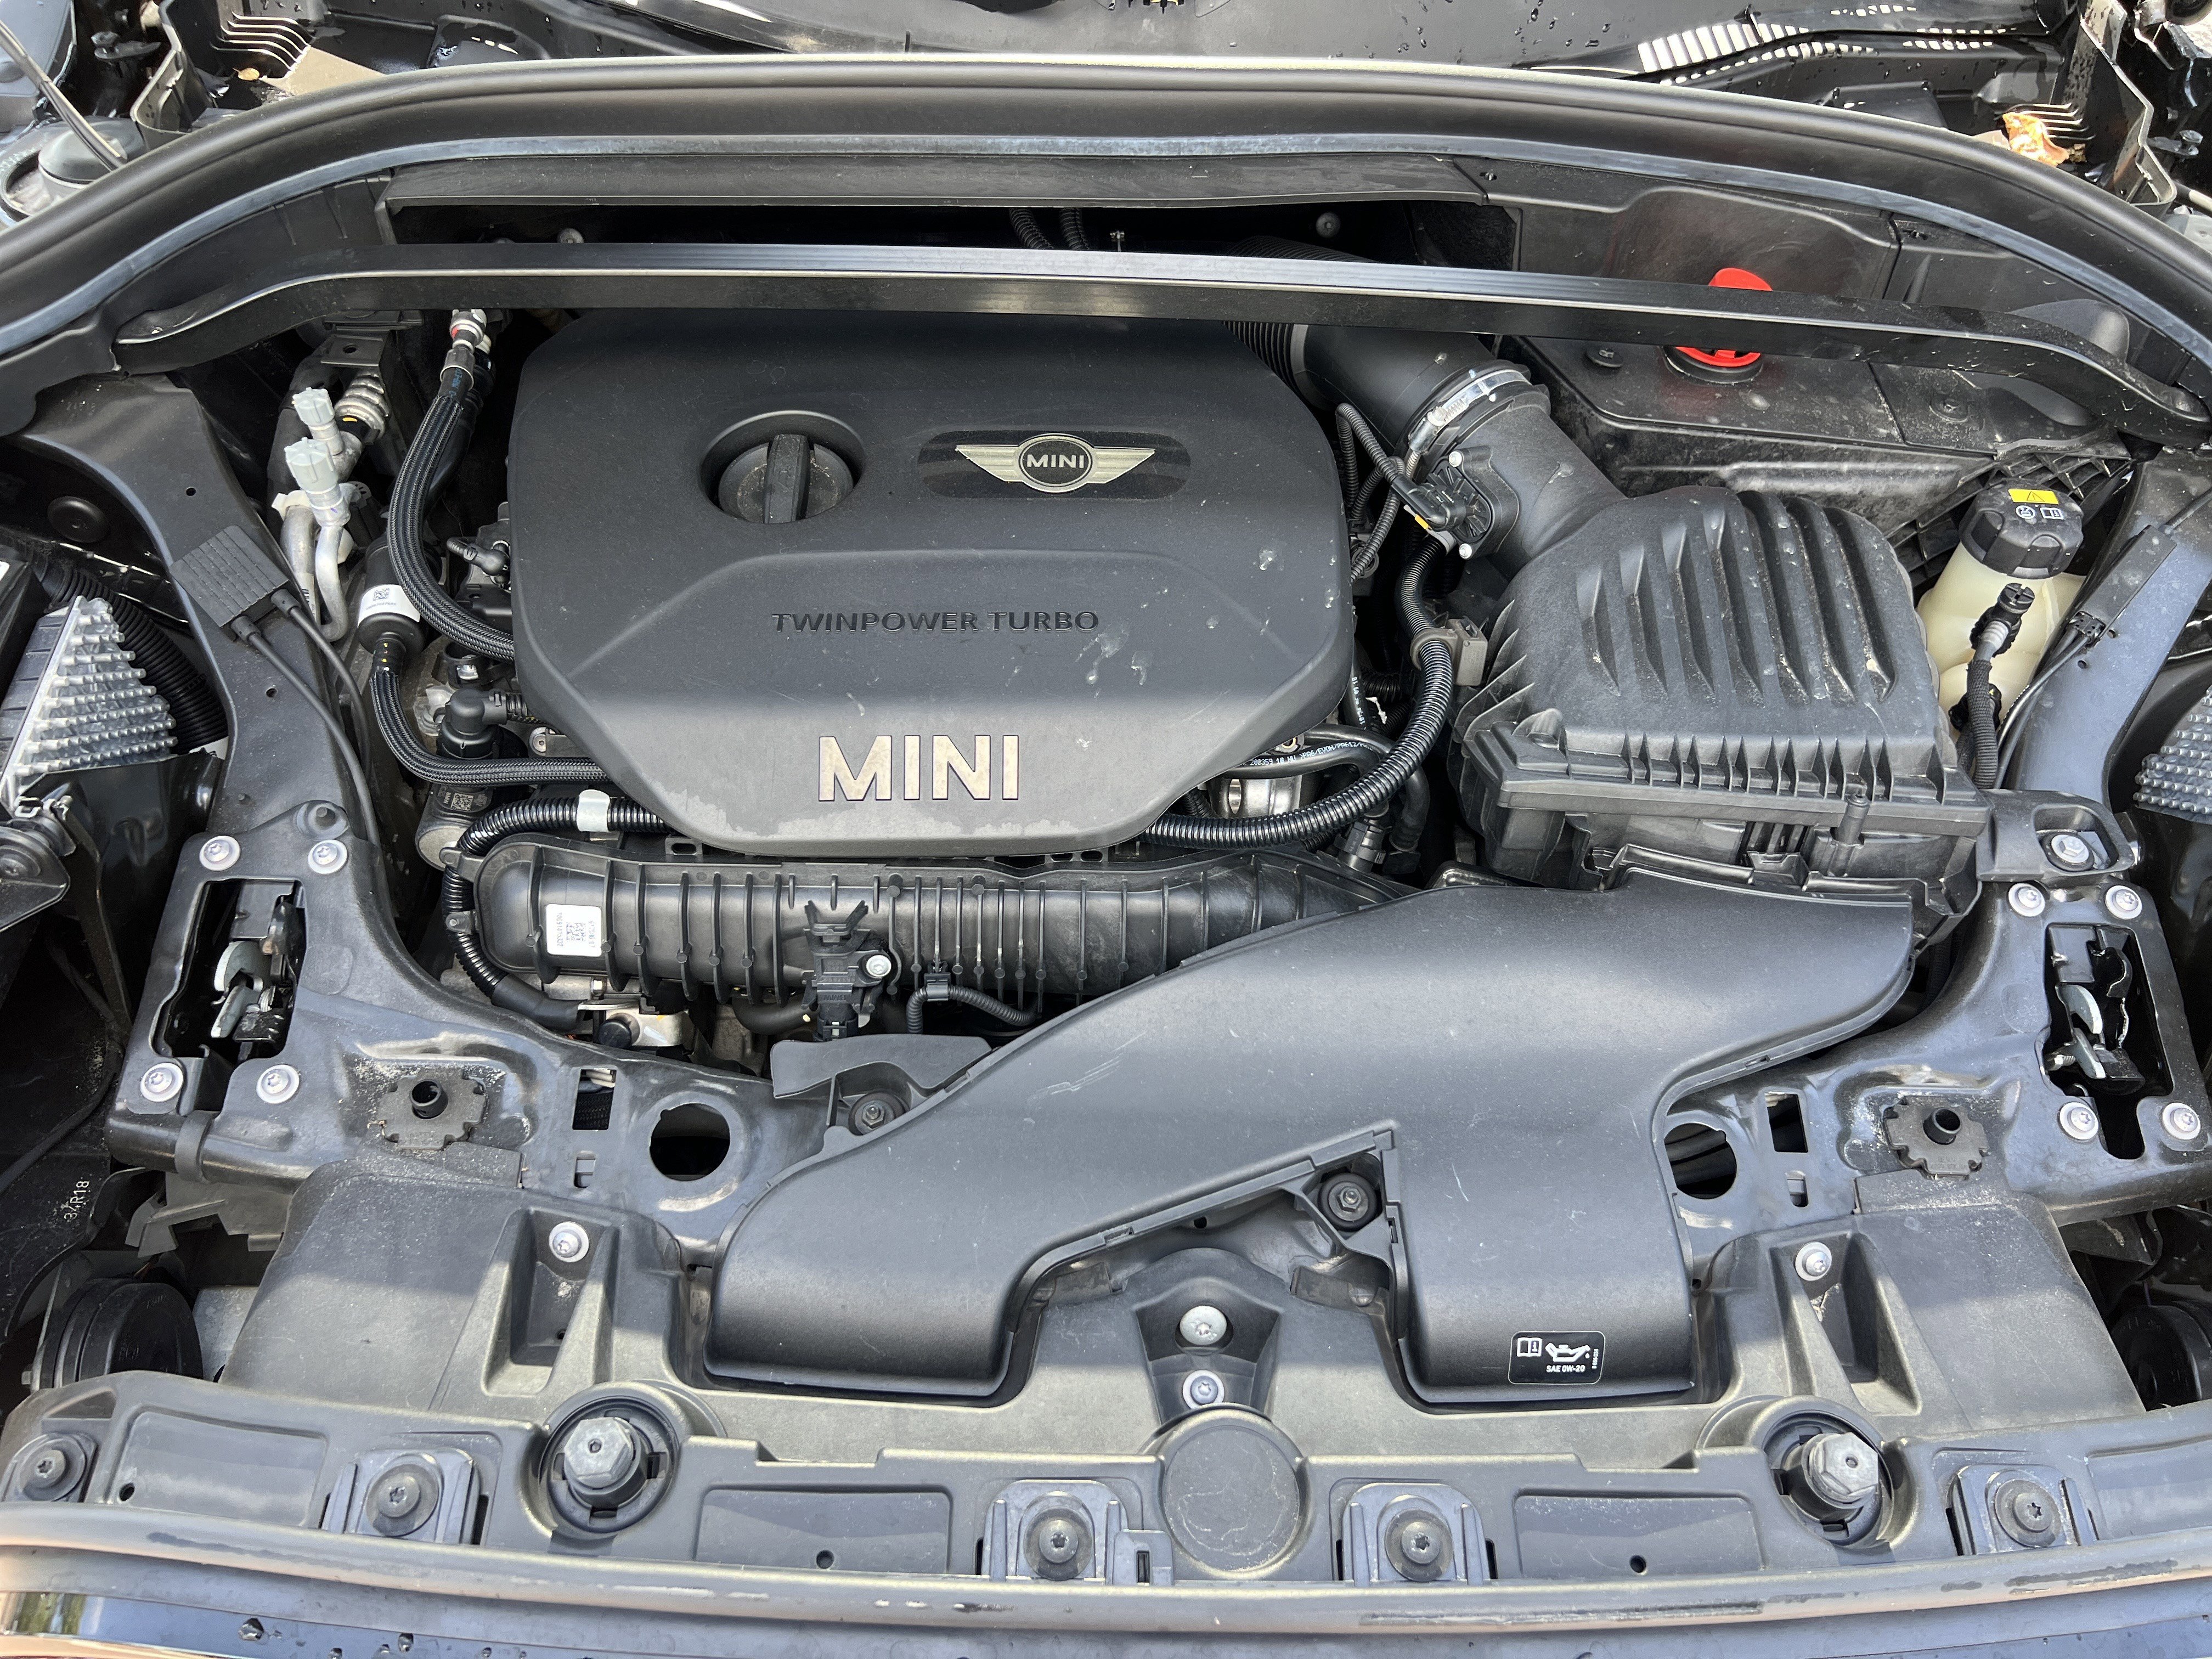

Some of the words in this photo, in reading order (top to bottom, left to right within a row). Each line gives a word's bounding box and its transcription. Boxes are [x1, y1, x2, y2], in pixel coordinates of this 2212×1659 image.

[1027, 454, 1084, 469] MINI
[771, 612, 978, 633] TWINPOWER
[988, 611, 1099, 633] TURBO
[819, 735, 1019, 802] MINI
[1562, 1364, 1585, 1373] 0W-20
